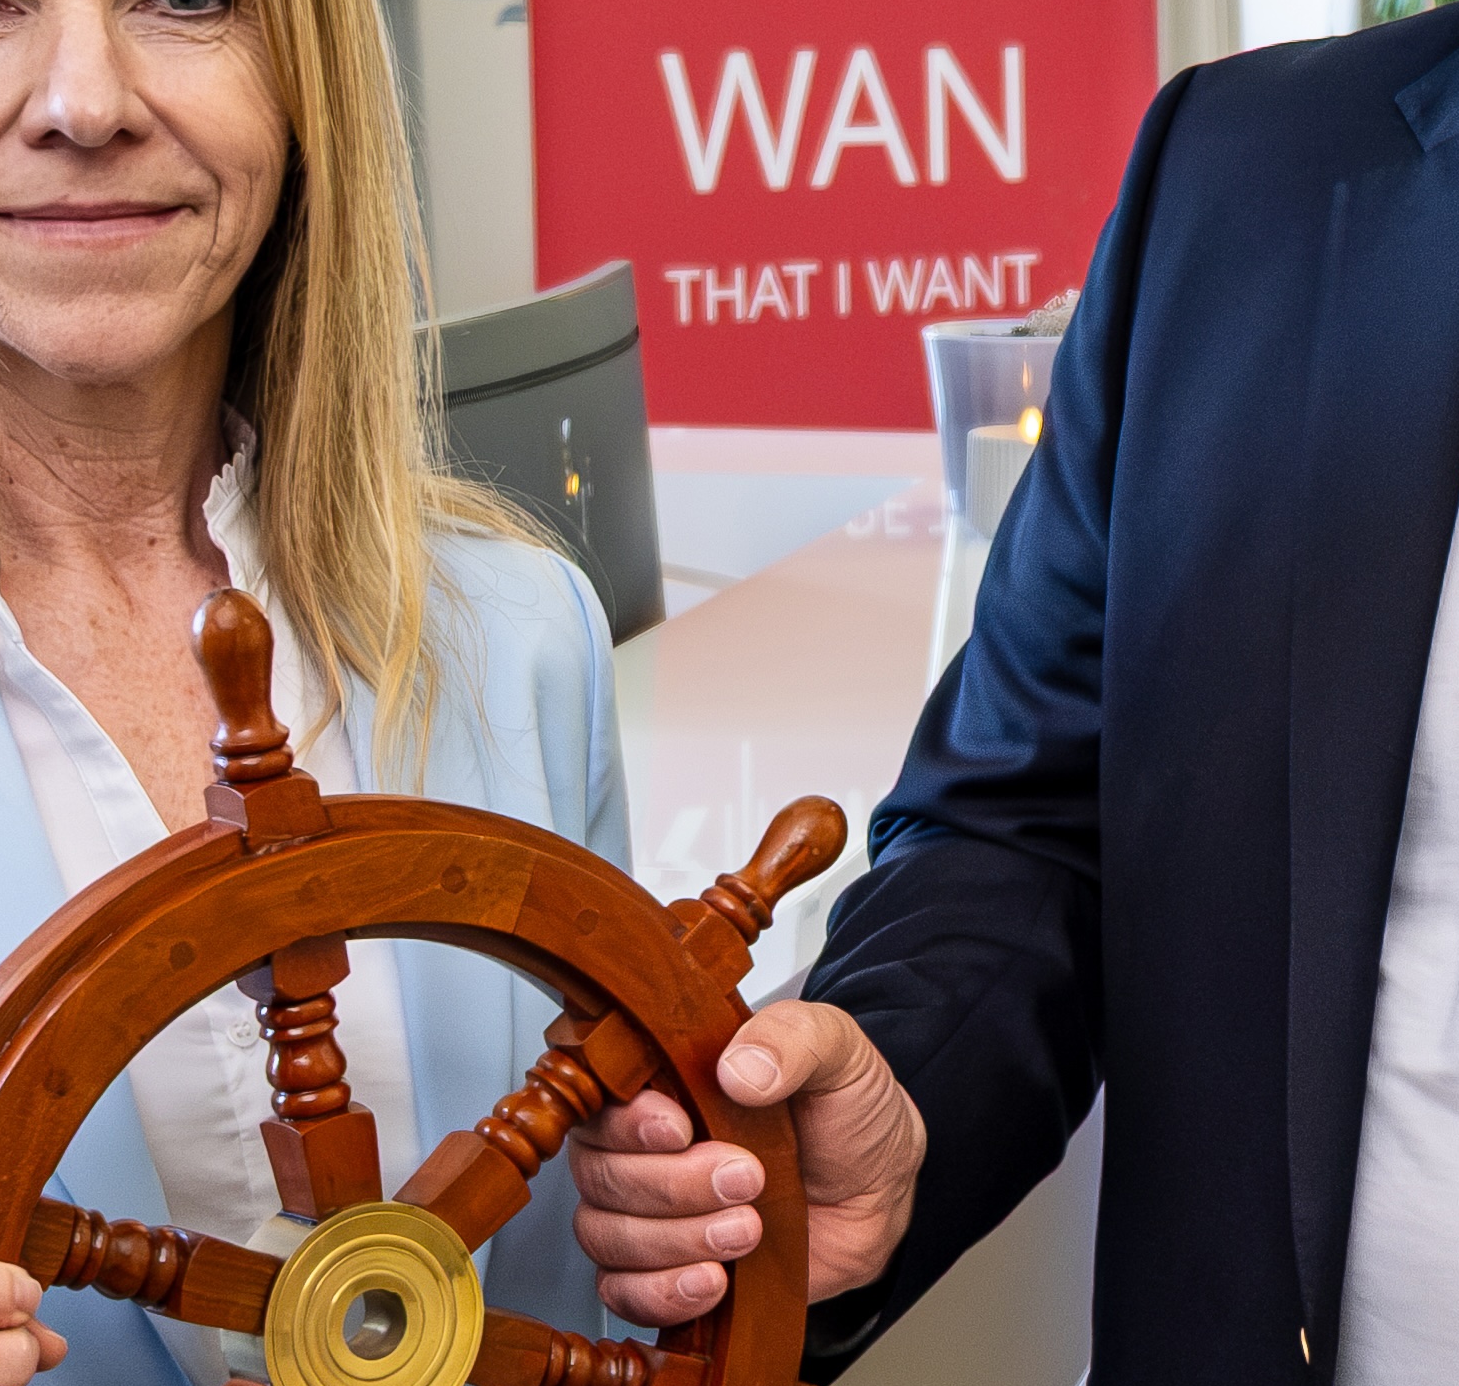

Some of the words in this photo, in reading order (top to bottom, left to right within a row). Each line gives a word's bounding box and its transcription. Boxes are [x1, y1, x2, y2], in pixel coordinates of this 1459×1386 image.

[659, 45, 1027, 194] WAN
[664, 261, 820, 324] THAT
[836, 262, 851, 316] I
[867, 252, 1038, 315] WANT
